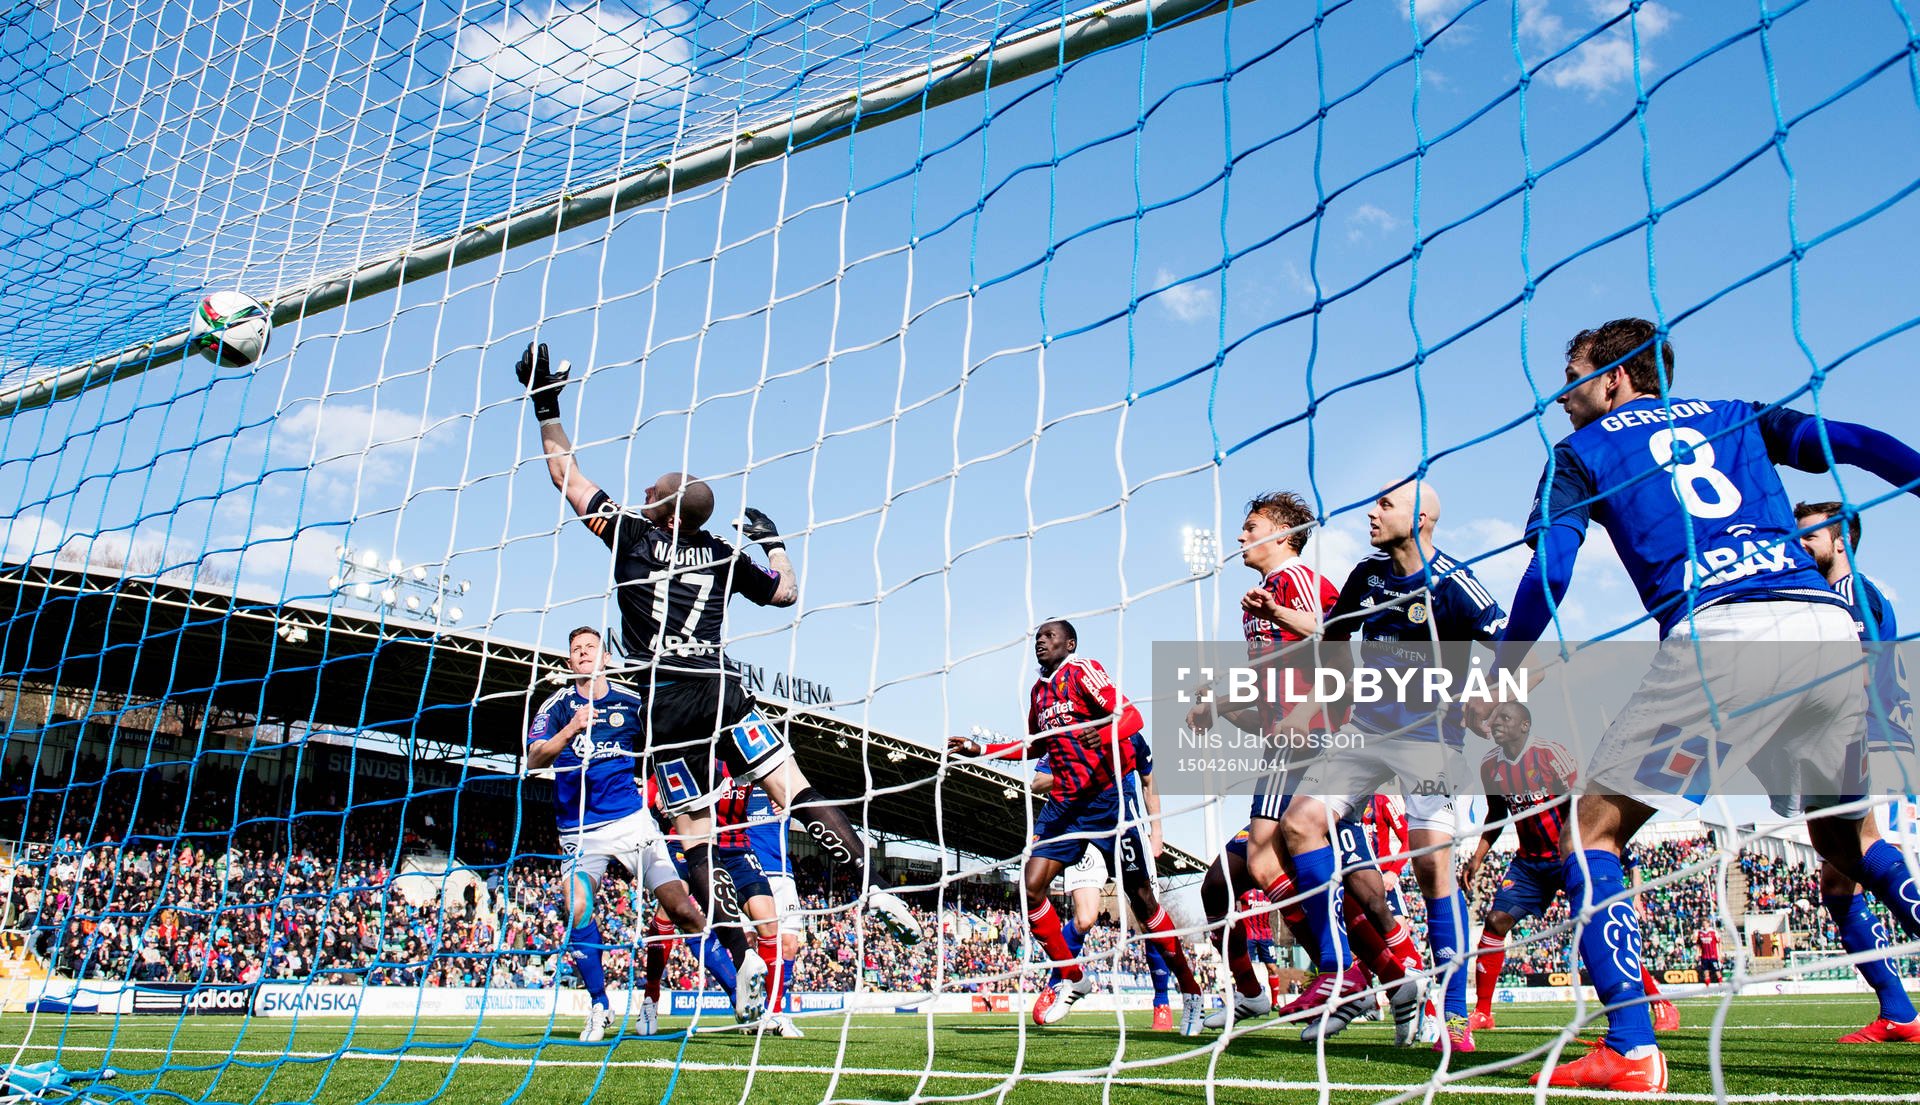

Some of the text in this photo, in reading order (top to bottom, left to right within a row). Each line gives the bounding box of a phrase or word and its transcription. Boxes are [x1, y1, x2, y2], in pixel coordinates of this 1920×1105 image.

[1600, 400, 1714, 432] GERSON
[1648, 426, 1743, 519] 8
[653, 540, 714, 566] NAURIN
[1683, 538, 1798, 592] ABAX
[648, 569, 715, 637] 17
[772, 672, 835, 711] ARENA
[1410, 779, 1458, 797] ABA
[264, 992, 360, 1011] SKANSKA
[464, 995, 513, 1010] SUNSVALLS
[674, 995, 696, 1009] HELA
